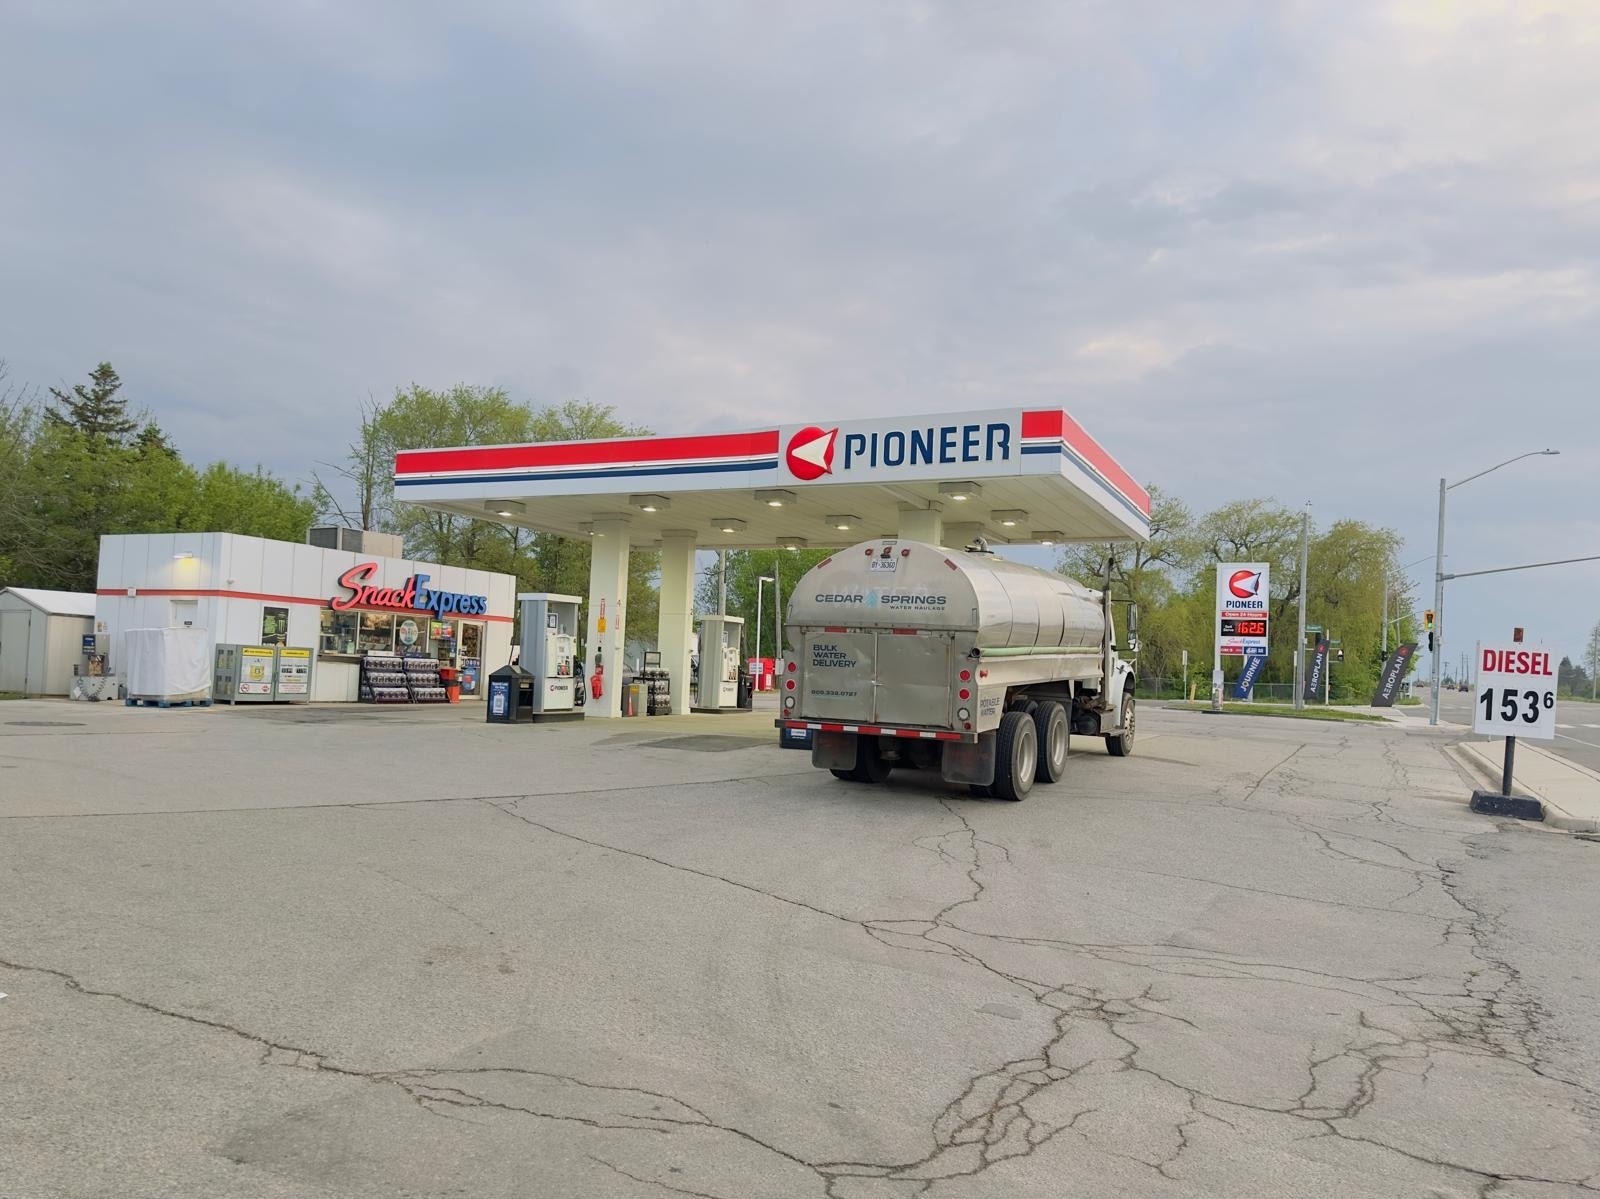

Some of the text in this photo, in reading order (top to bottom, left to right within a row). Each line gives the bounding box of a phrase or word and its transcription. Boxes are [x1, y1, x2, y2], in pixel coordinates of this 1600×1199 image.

[844, 422, 1011, 470] PIONEER
[815, 594, 947, 605] CEDAR SPRINGS
[1226, 600, 1263, 609] PIONEER
[813, 644, 838, 652] BULK
[812, 659, 857, 668] DELIVERY
[1240, 657, 1261, 692] JOURNIE
[1310, 653, 1323, 693] AEROPLAN
[1482, 649, 1553, 676] DIESEL
[1382, 656, 1405, 700] AEROPLAN
